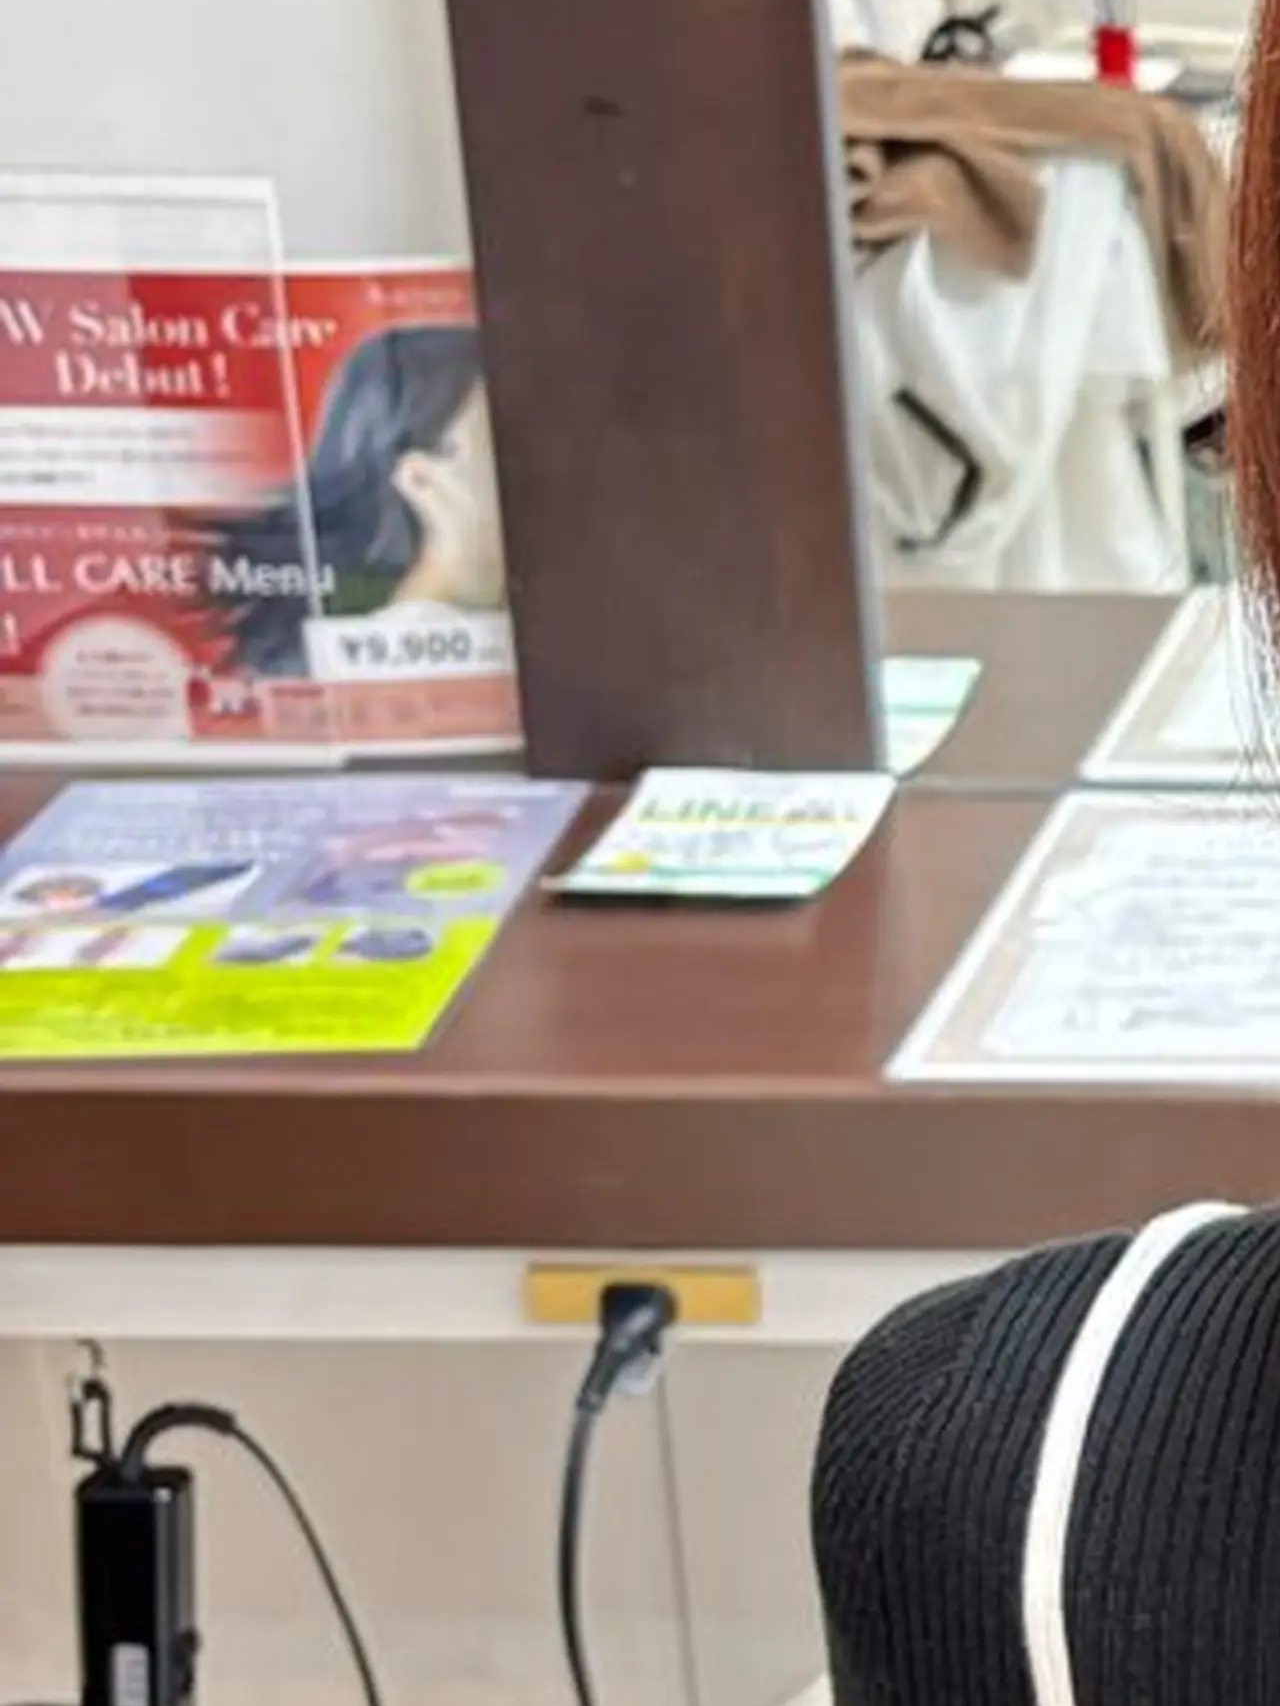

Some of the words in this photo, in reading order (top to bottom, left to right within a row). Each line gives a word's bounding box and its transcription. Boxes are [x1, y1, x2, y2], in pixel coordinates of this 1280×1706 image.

[69, 298, 210, 349] Salon
[220, 299, 338, 349] Care
[73, 551, 198, 597] CARE
[210, 553, 336, 597] Menu
